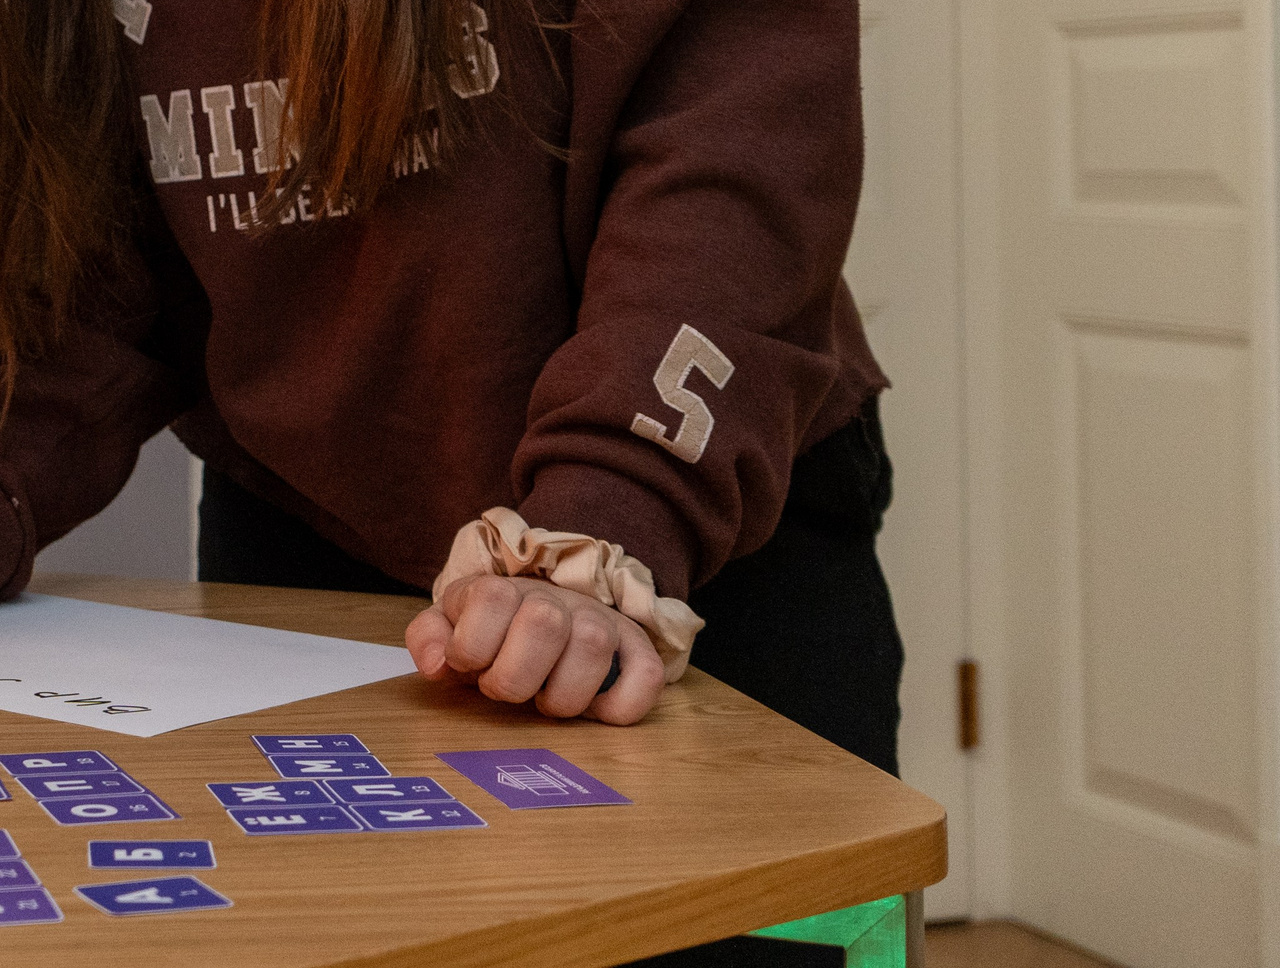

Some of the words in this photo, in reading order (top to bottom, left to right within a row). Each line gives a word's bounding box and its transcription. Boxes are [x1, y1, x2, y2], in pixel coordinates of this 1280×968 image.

[277, 739, 323, 749] Н
[22, 758, 68, 769] Р
[295, 759, 344, 773] М
[43, 779, 94, 792] П
[351, 783, 405, 797] Л
[231, 785, 287, 803] Ж
[70, 803, 119, 818] О
[378, 808, 433, 822] К
[243, 814, 307, 826] Ё
[113, 848, 164, 861] Б
[115, 886, 174, 904] А
